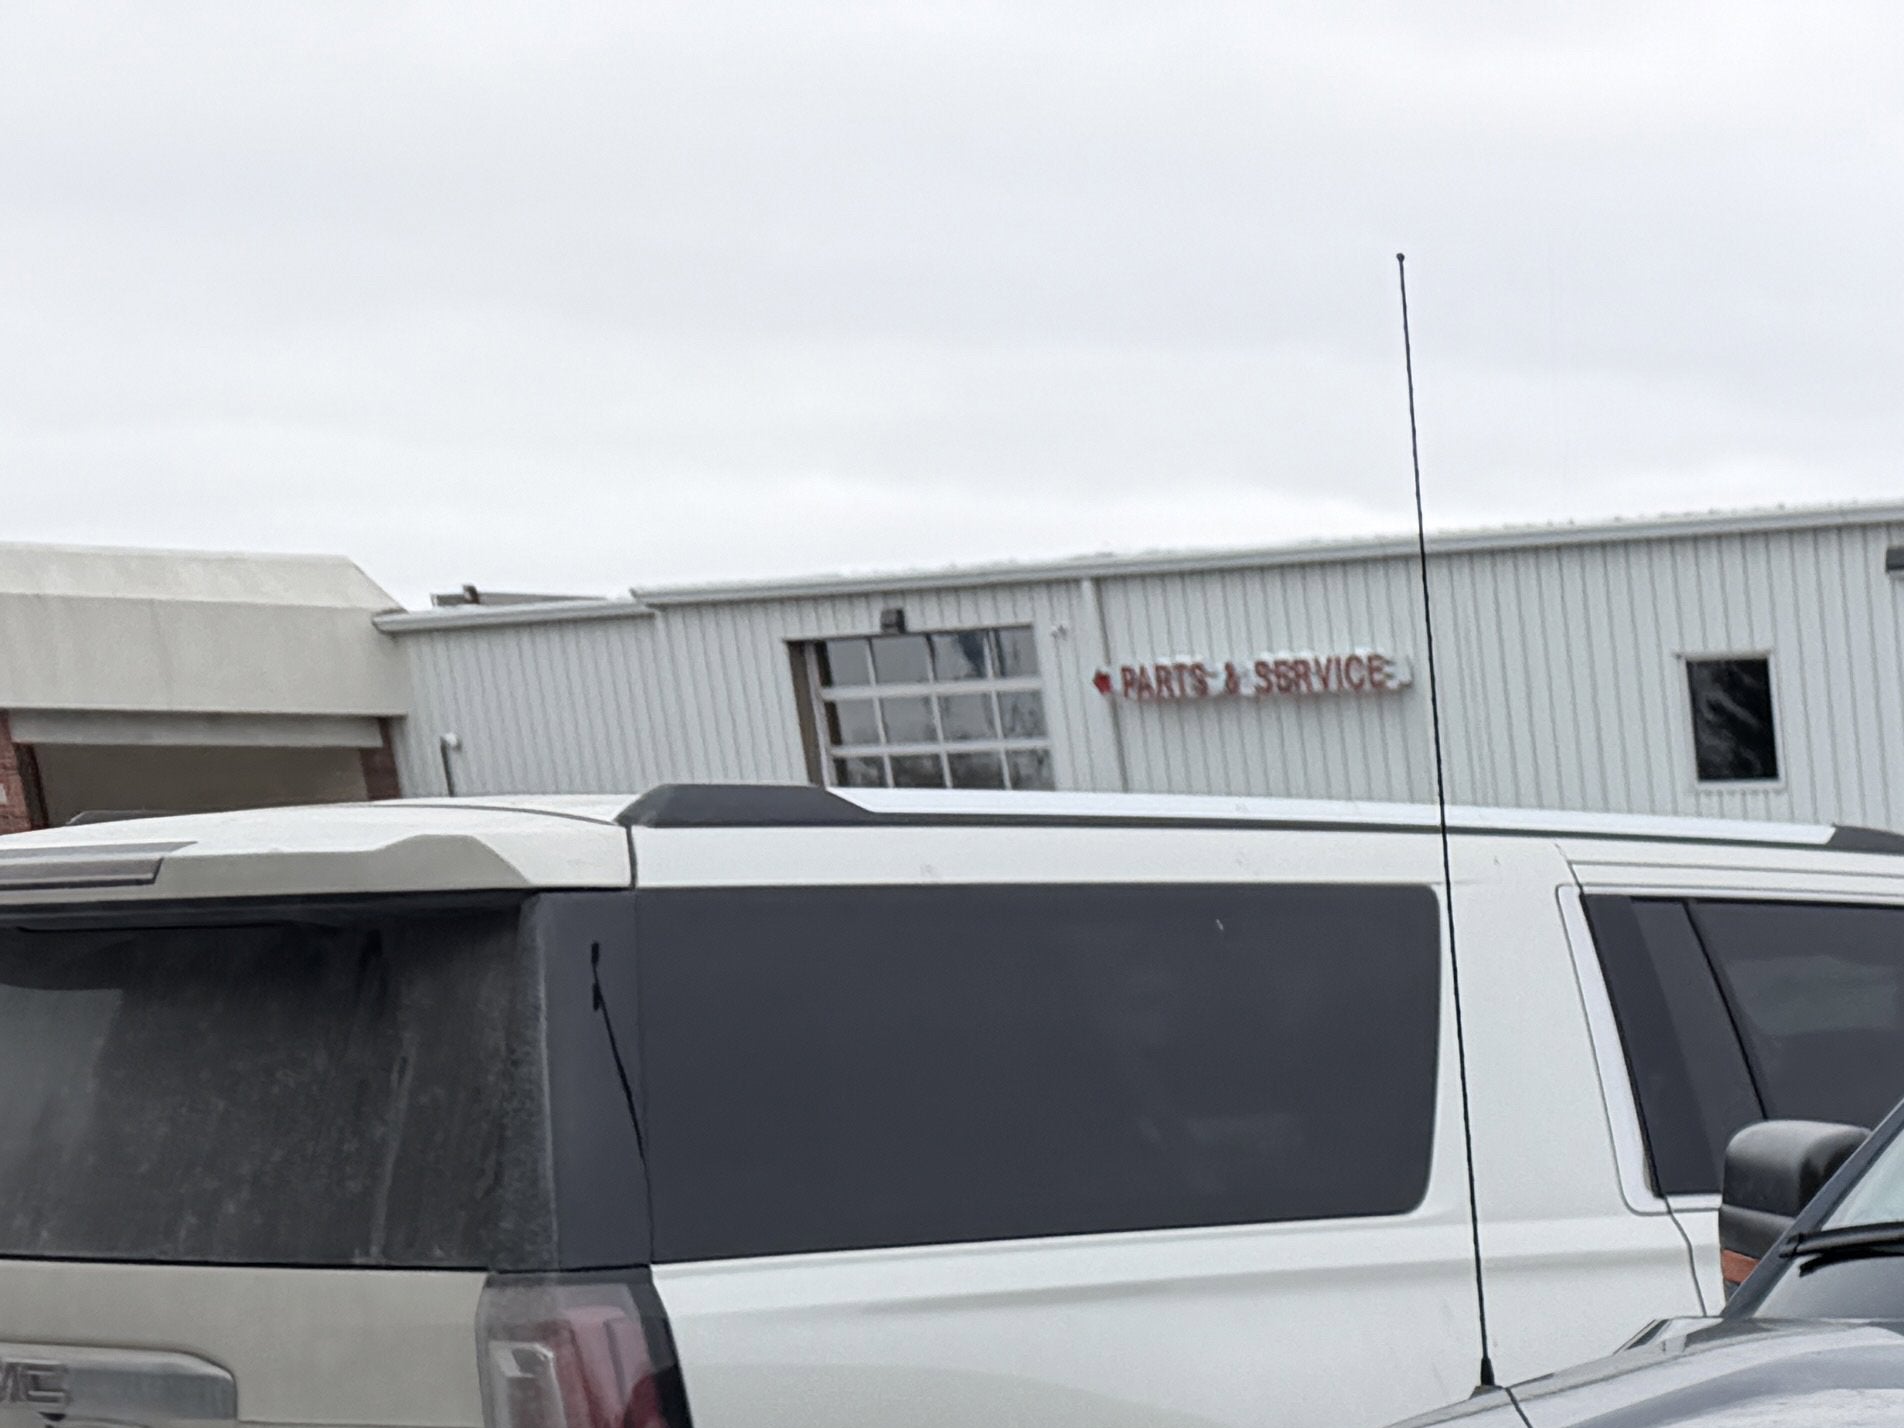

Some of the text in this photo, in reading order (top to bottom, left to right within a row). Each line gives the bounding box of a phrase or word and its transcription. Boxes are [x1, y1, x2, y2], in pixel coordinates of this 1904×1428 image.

[1120, 654, 1390, 699] PARTS & SERVICE
